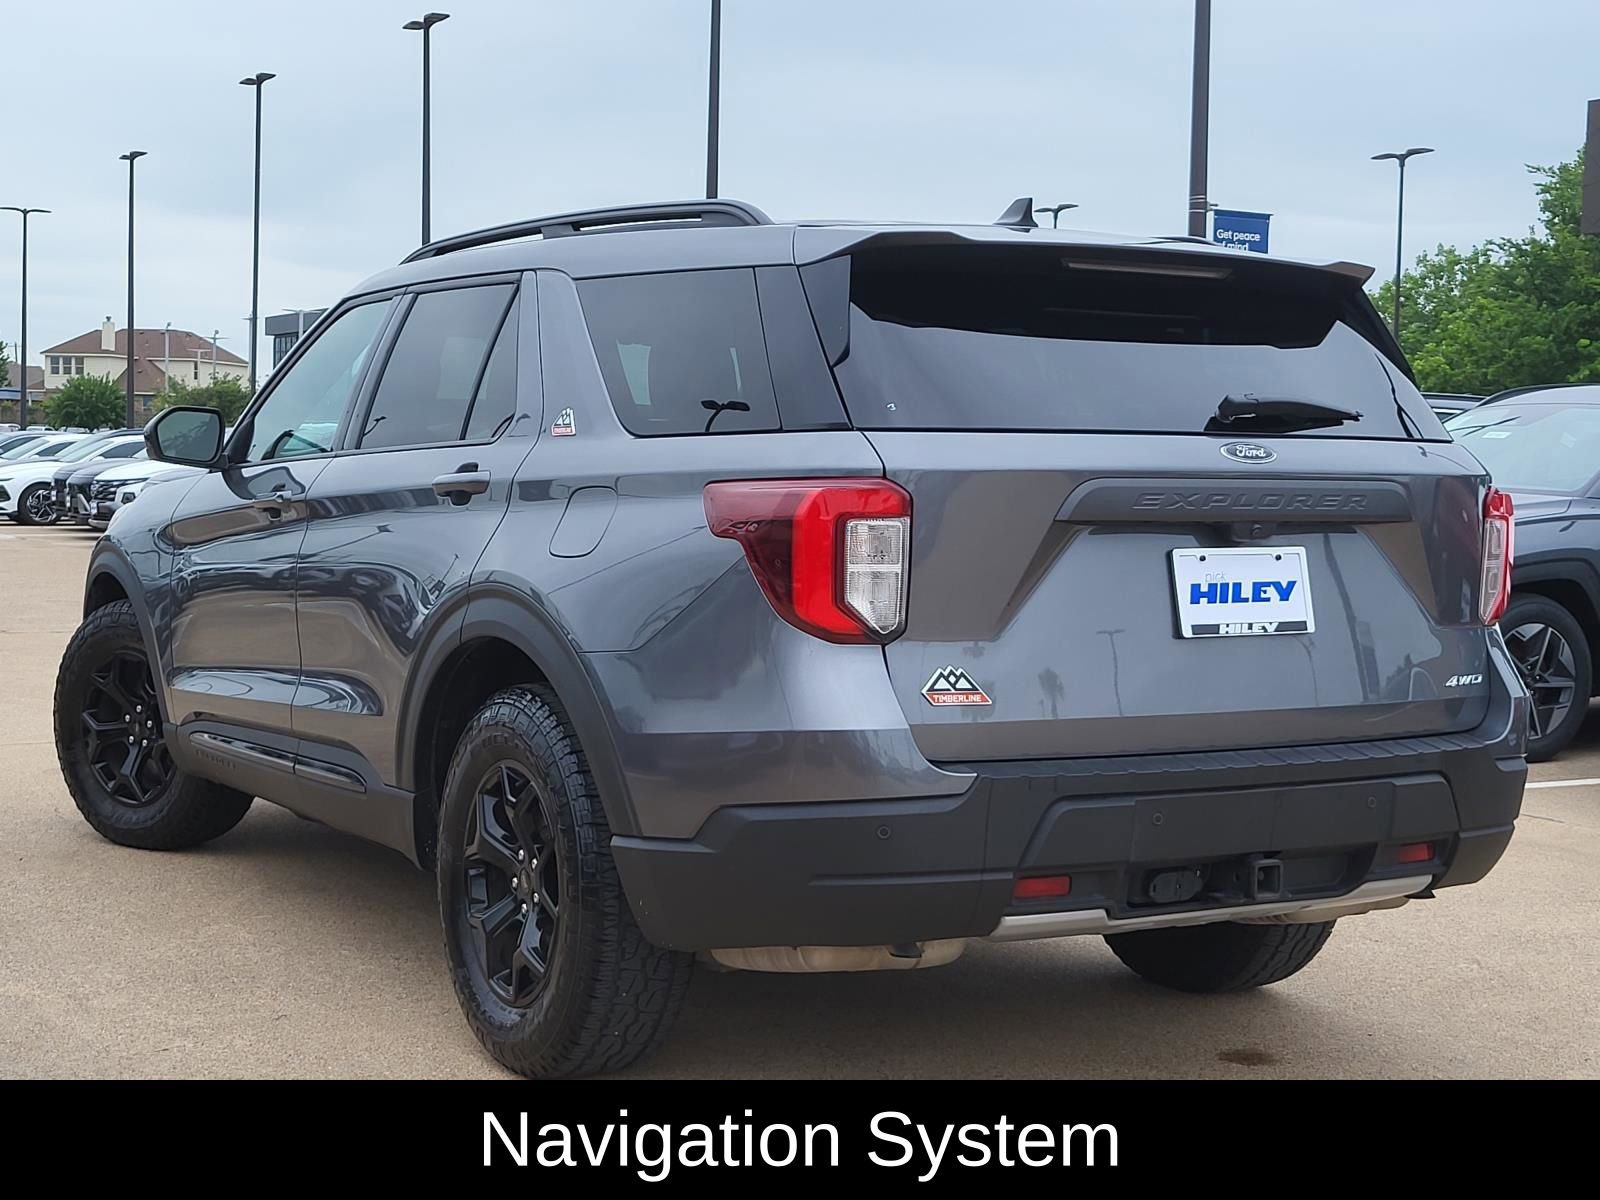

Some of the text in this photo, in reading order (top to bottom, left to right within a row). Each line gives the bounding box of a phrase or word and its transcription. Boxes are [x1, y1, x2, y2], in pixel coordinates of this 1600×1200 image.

[1216, 229, 1261, 241] Get peace
[1236, 444, 1266, 457] Ford
[1132, 492, 1368, 510] EXPLORER
[1190, 581, 1297, 604] HILEY
[1219, 623, 1279, 634] HILEY
[1445, 673, 1483, 687] 4WD
[932, 694, 982, 703] TIMBERLINE
